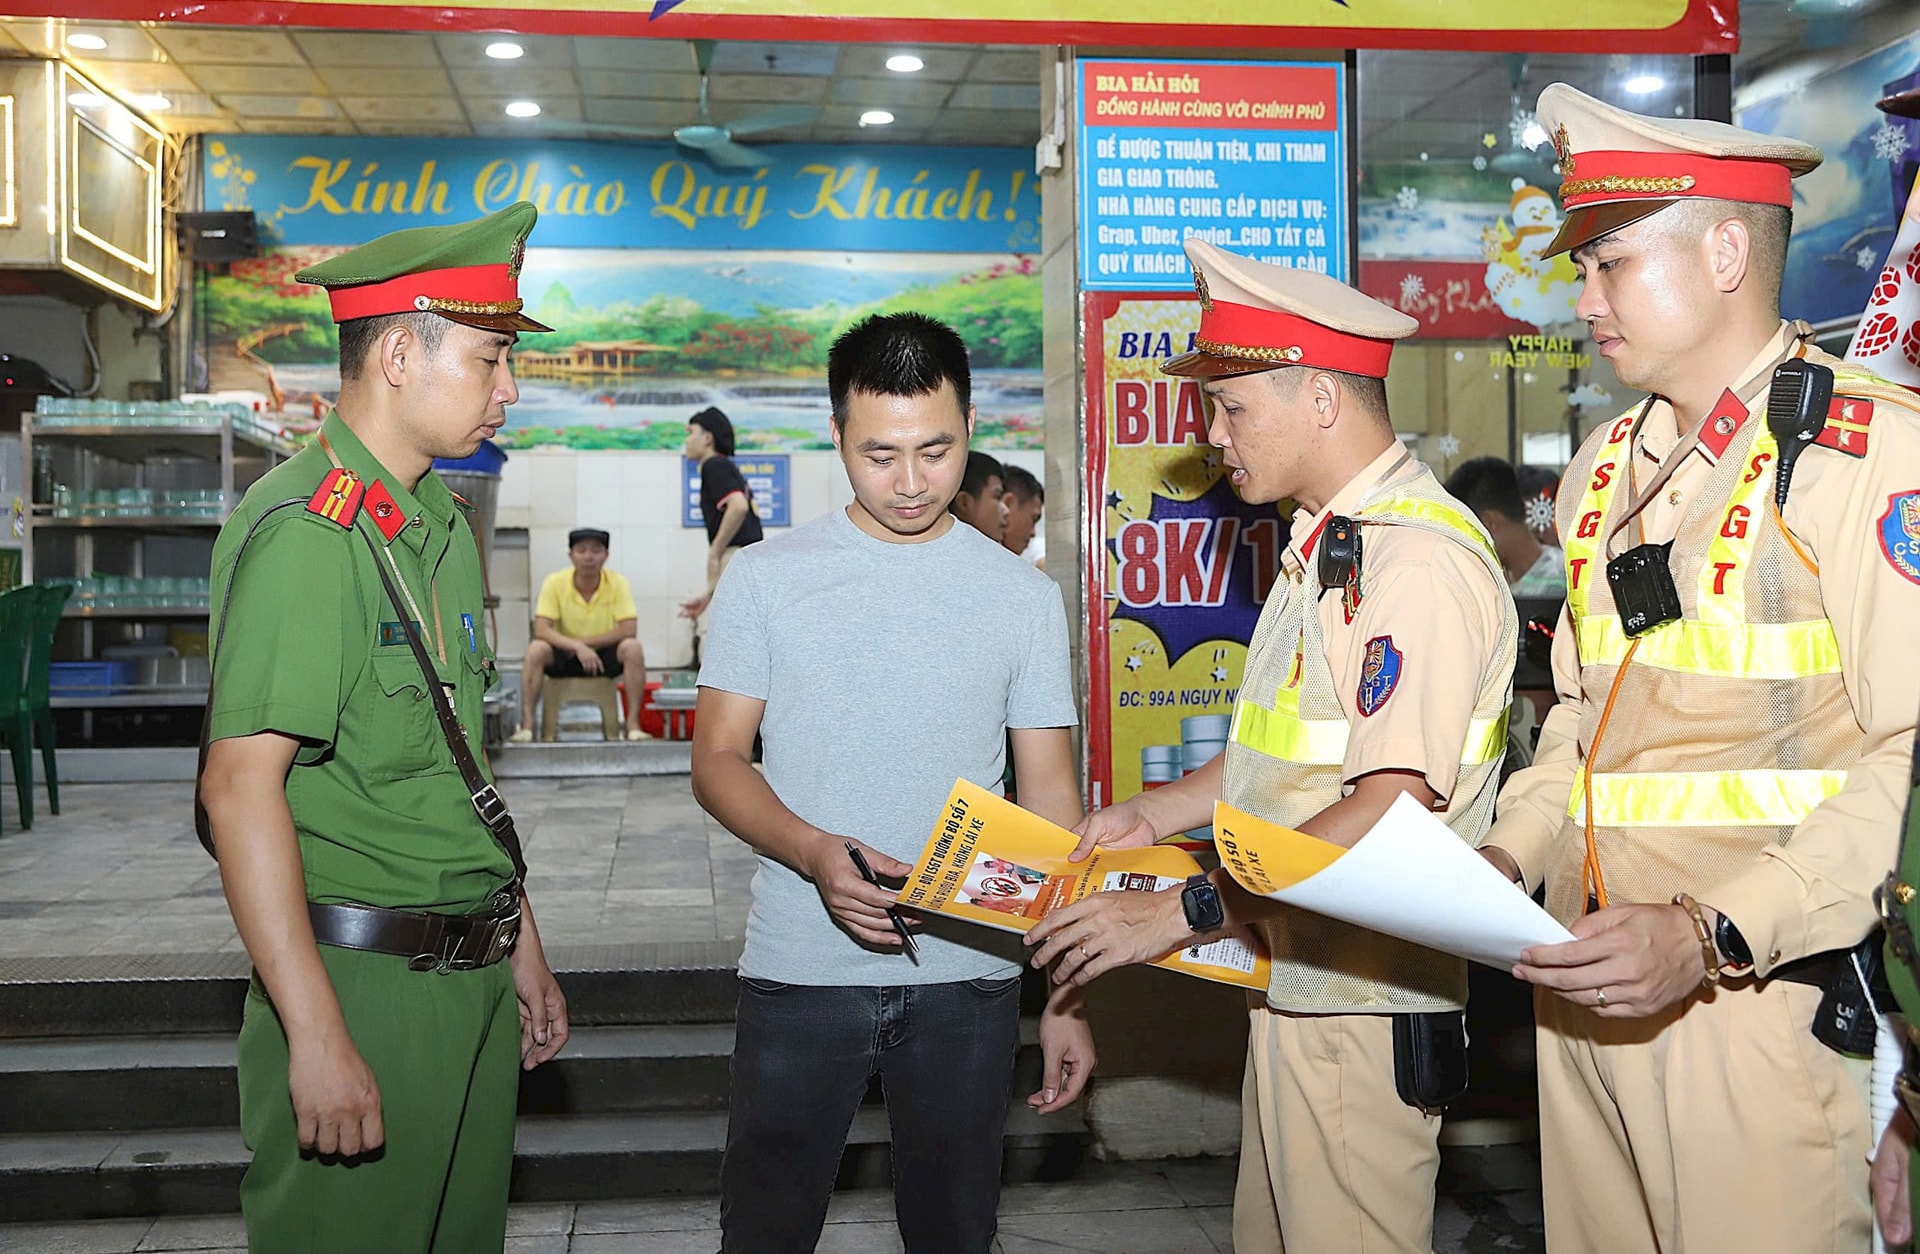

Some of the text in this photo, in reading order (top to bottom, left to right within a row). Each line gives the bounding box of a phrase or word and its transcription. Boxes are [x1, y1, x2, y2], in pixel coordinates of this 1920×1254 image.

[1096, 75, 1129, 92] BIA
[1164, 137, 1213, 164] THUẬN
[1216, 139, 1252, 164] TIỆN,
[1255, 143, 1281, 162] KHI
[1284, 143, 1326, 162] THAM
[1097, 166, 1219, 189] GIA GIAO THÔNG.
[279, 156, 454, 215] Kính
[474, 159, 632, 216] Chào
[650, 160, 773, 230] Quý
[1097, 194, 1130, 216] NHÀ
[1133, 194, 1175, 217] HÀNG
[1179, 197, 1222, 217] CUNG
[1260, 198, 1298, 222] DỊCH
[1098, 225, 1138, 248] Grap,
[1141, 225, 1180, 247] Uber,
[1099, 250, 1130, 275] QUÝ
[1133, 251, 1186, 274] KHÁCH
[1118, 332, 1172, 358] BIA
[1114, 380, 1209, 447] BIA
[1119, 690, 1144, 707] ĐC:
[1180, 688, 1221, 709] NGỤY
[950, 803, 966, 822] SỐ
[958, 798, 969, 808] 7
[945, 819, 963, 834] BỘ
[1223, 827, 1235, 839] 7
[933, 832, 954, 861] ĐƯỜNG
[952, 844, 973, 870] KHÔNG
[970, 816, 985, 832] XE
[1219, 837, 1240, 858] SỐ
[925, 857, 943, 875] CSGT
[1246, 849, 1261, 866] XE
